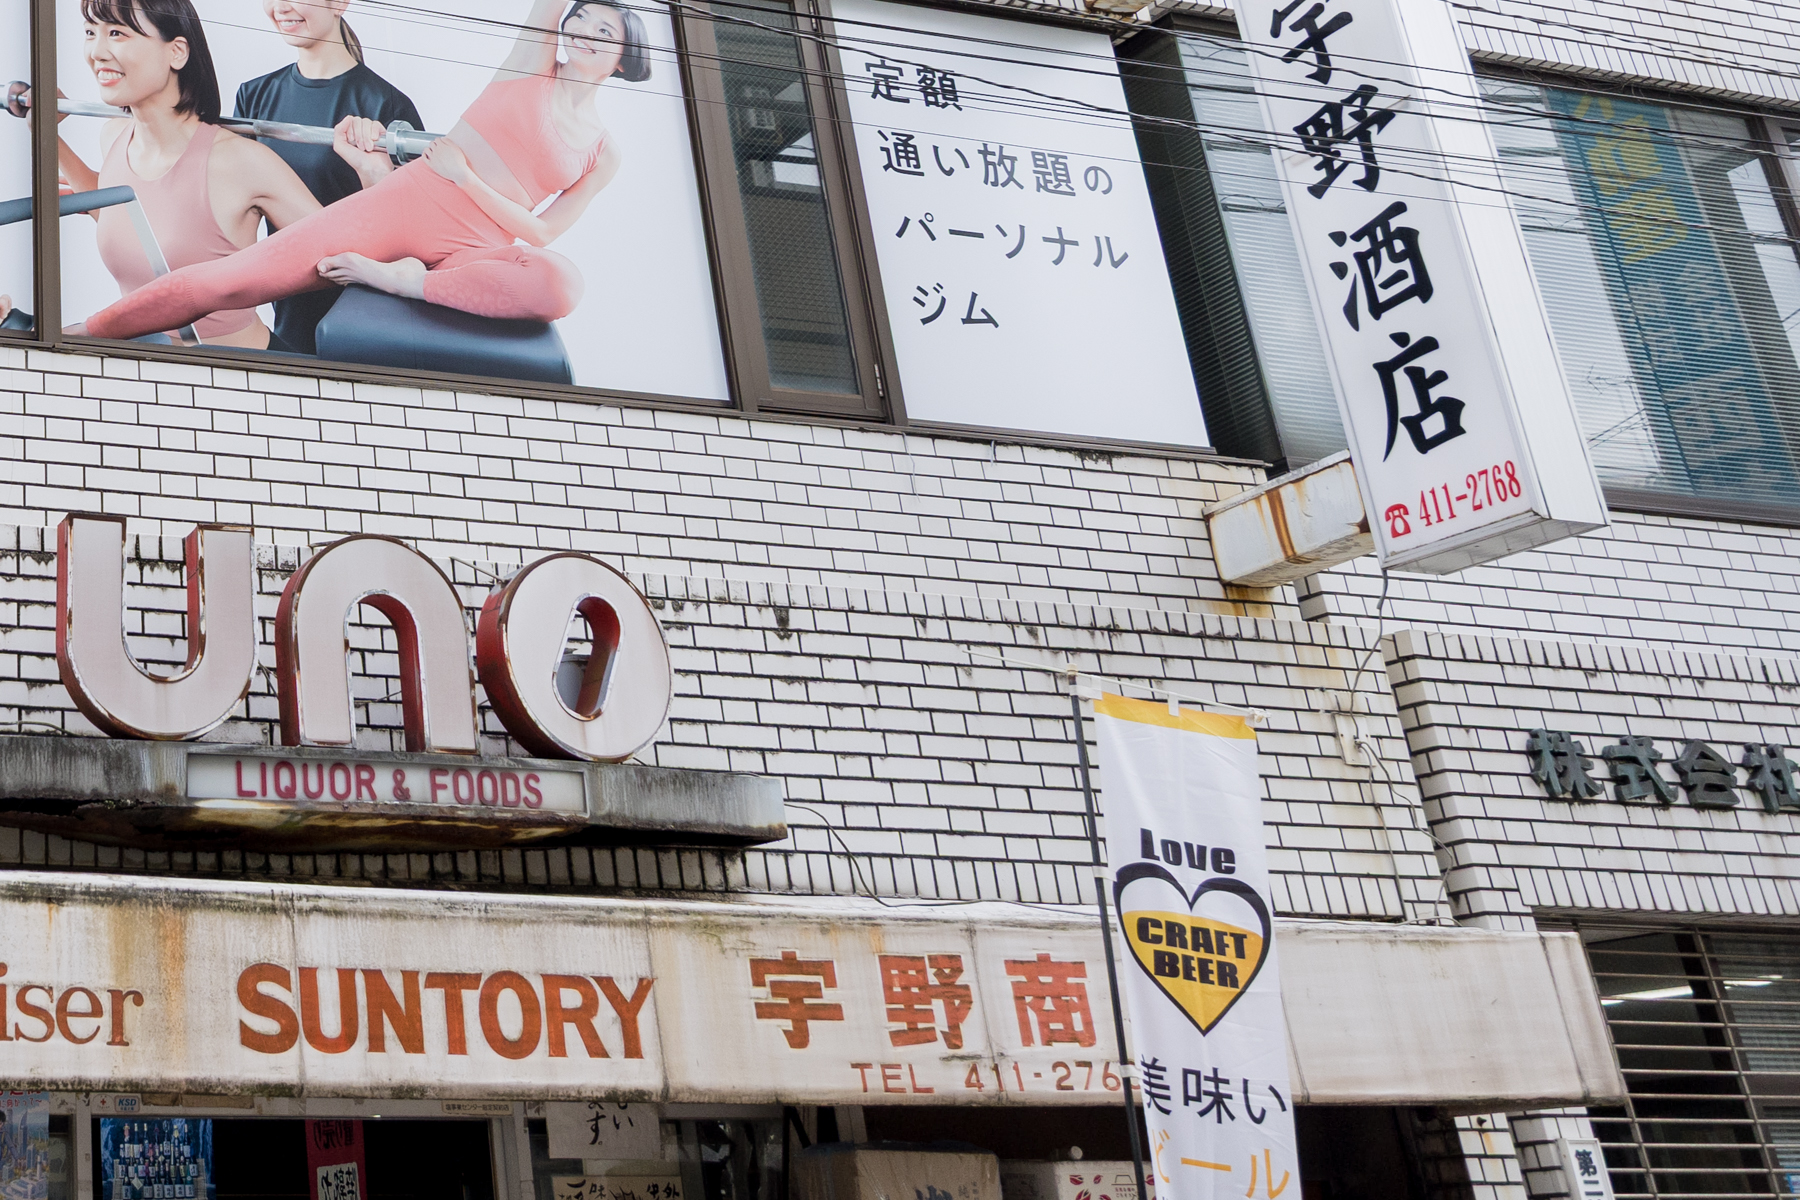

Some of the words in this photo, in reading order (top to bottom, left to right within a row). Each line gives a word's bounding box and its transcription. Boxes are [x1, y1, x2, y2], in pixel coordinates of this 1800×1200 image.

[864, 60, 963, 112] 定額
[878, 130, 1113, 197] 通い放題の
[895, 212, 1129, 269] パーソナル
[912, 282, 1000, 329] ジム
[1419, 459, 1522, 527] 411-2768
[235, 759, 375, 802] LIQUOR
[392, 768, 412, 802] &
[430, 768, 544, 809] FOODS
[1526, 728, 1800, 814] 株式会社
[1136, 916, 1248, 960] CRAFT
[1153, 949, 1240, 990] BEER
[237, 961, 659, 1060] SUNTORY
[749, 950, 1097, 1051] 宇野商
[118, 1098, 137, 1106] KSD
[850, 1062, 935, 1094] TEL
[1141, 1053, 1288, 1125] 美味い
